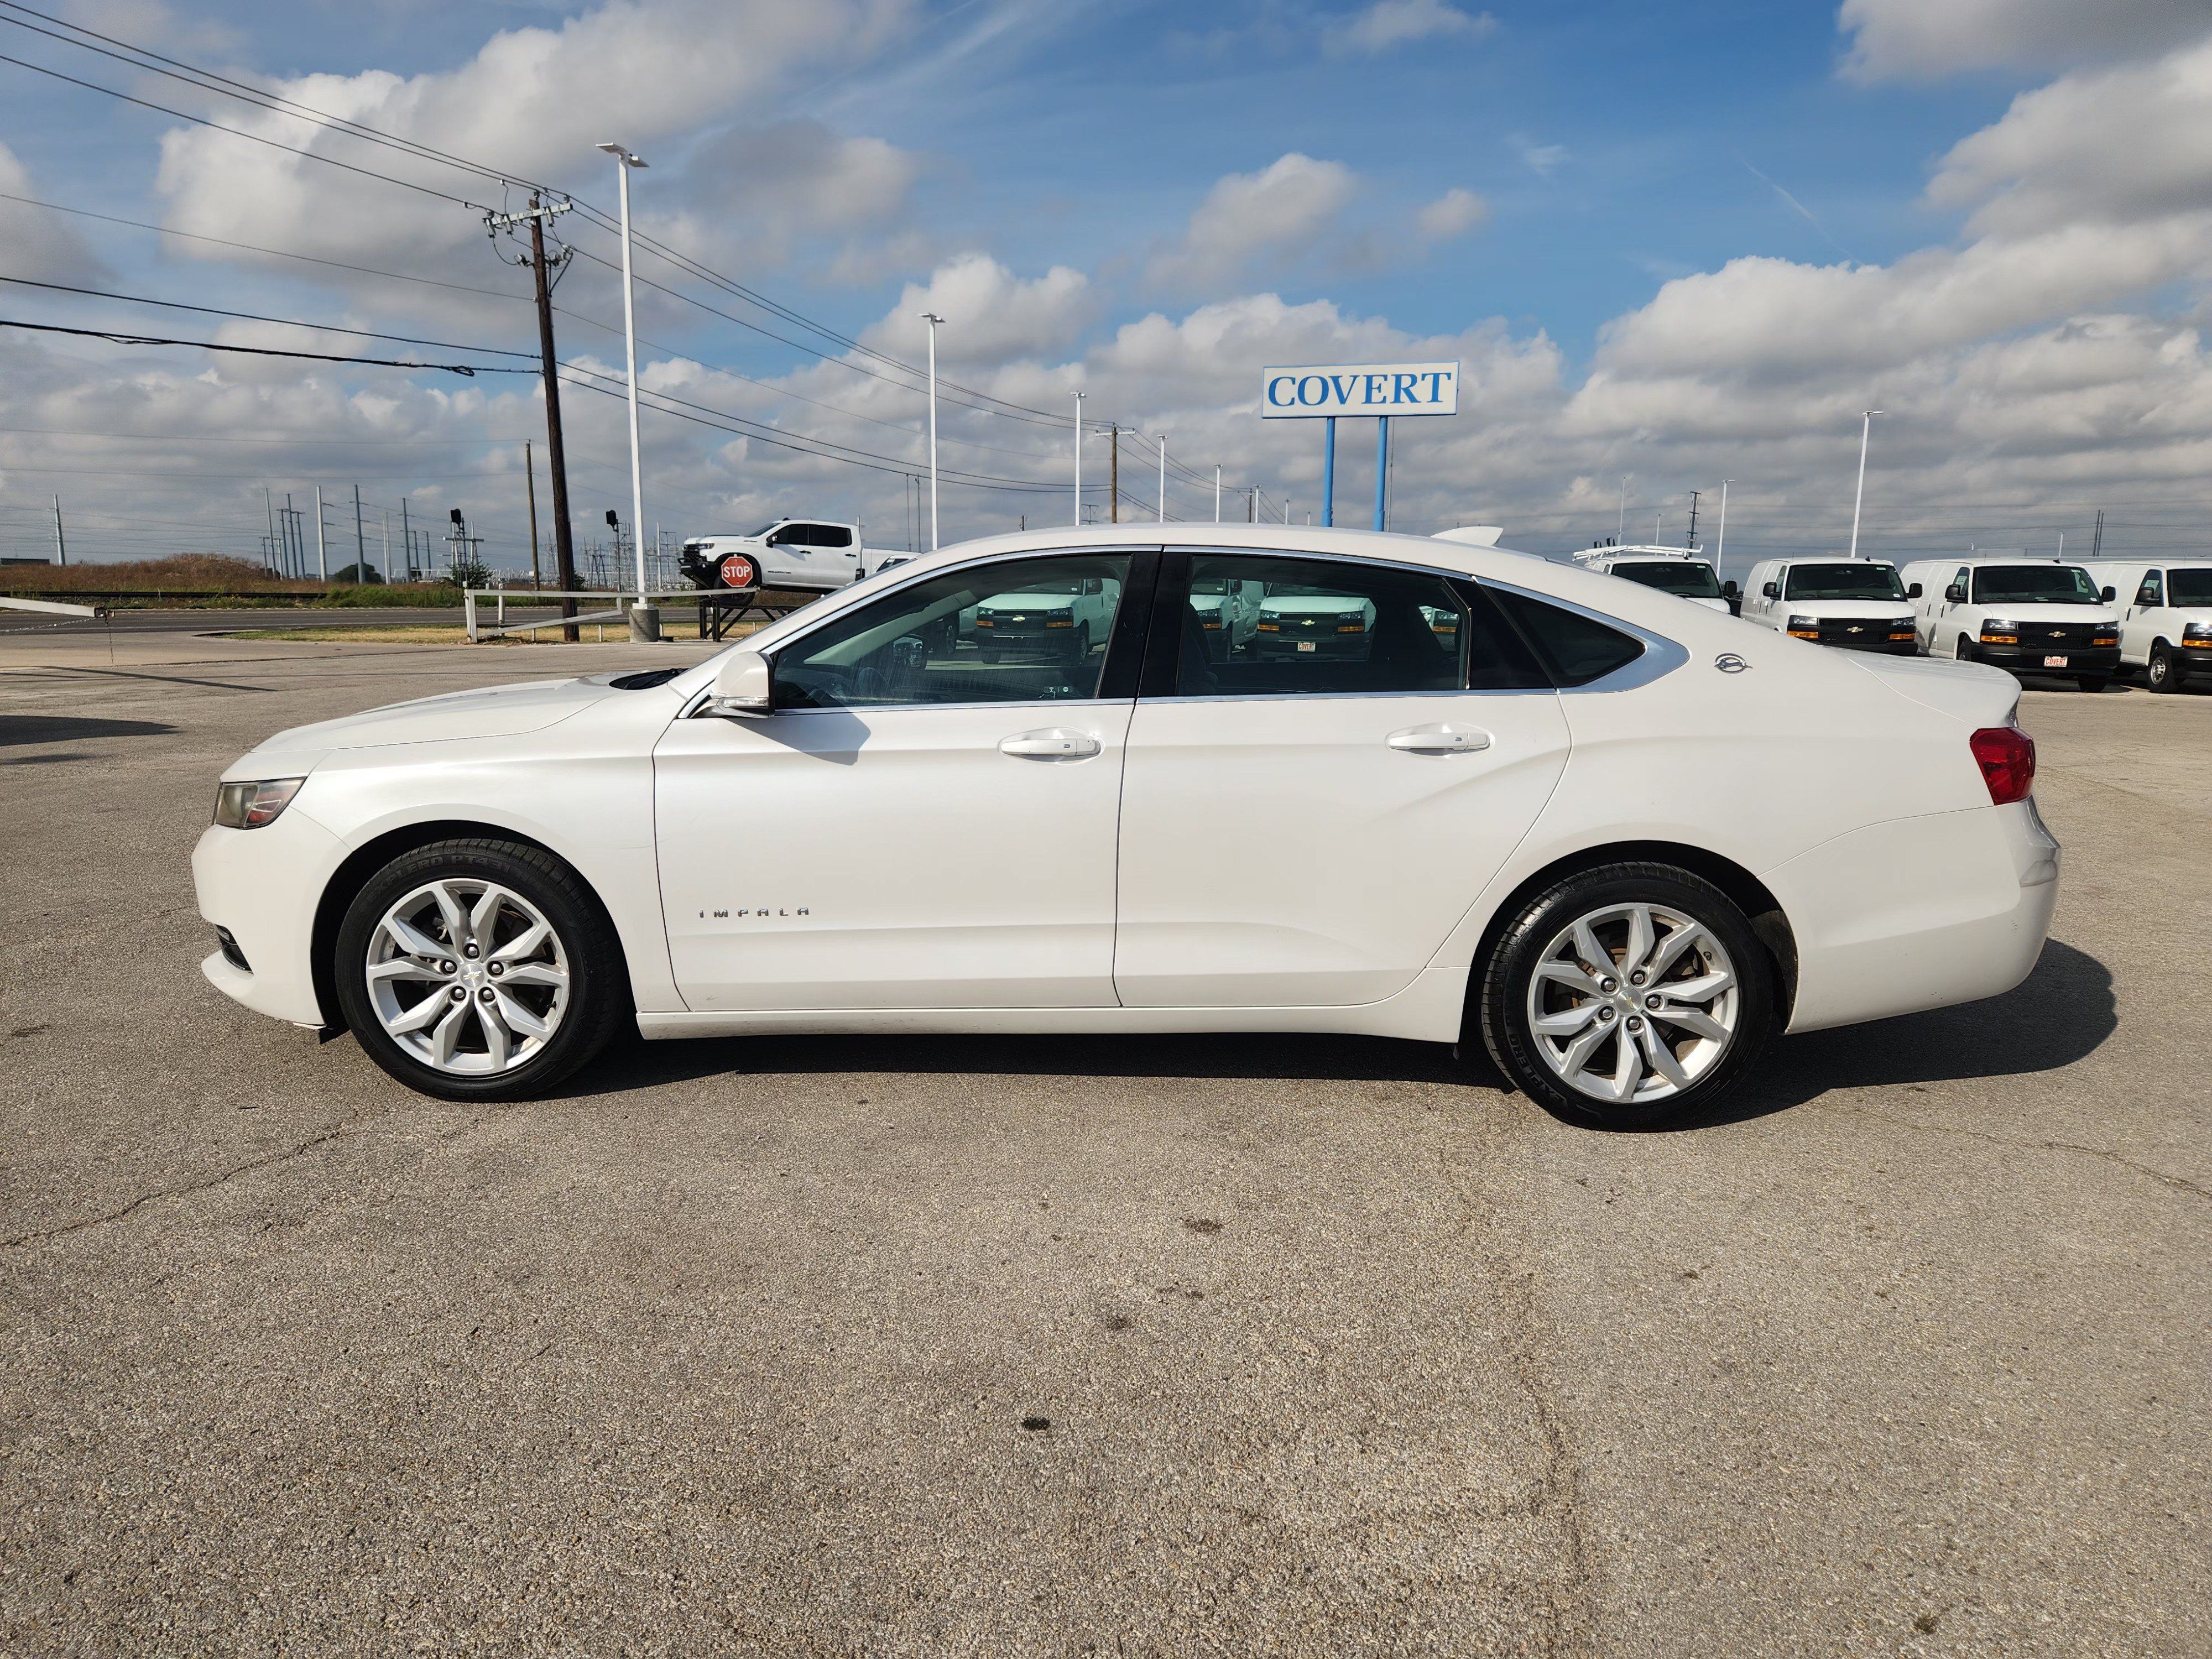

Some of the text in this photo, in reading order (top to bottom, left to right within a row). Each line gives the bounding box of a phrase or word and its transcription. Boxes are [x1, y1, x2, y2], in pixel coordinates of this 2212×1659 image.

[1268, 372, 1452, 406] COVERT
[724, 566, 750, 578] STOP
[699, 907, 809, 918] IMPALA
